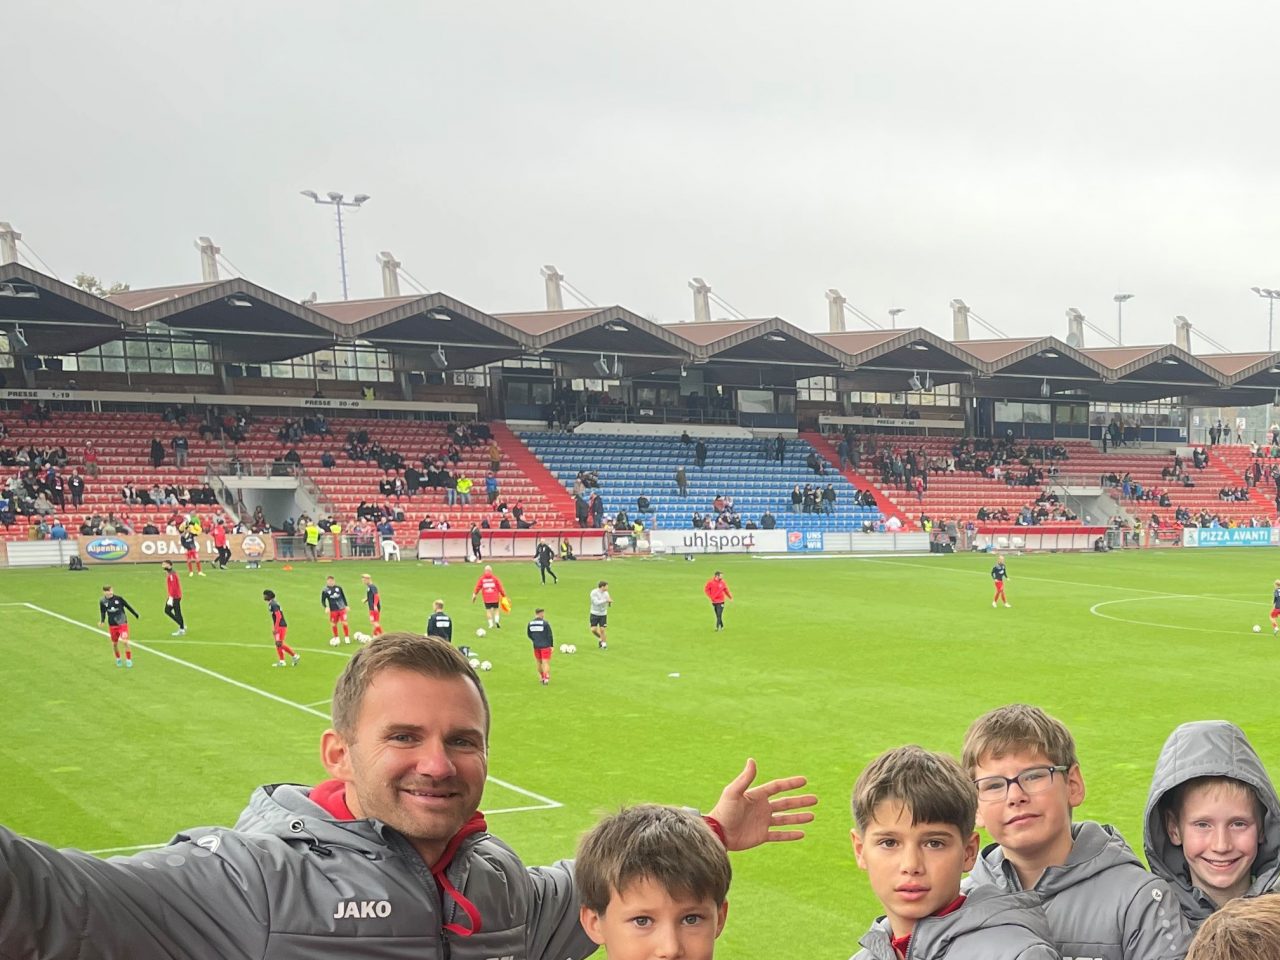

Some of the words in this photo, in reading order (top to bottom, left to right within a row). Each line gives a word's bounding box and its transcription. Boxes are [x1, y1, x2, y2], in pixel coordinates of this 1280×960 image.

[683, 532, 756, 549] uhlsport
[1200, 531, 1229, 541] PIZZA
[1233, 530, 1269, 541] AVANTI
[333, 900, 392, 919] JAKO
